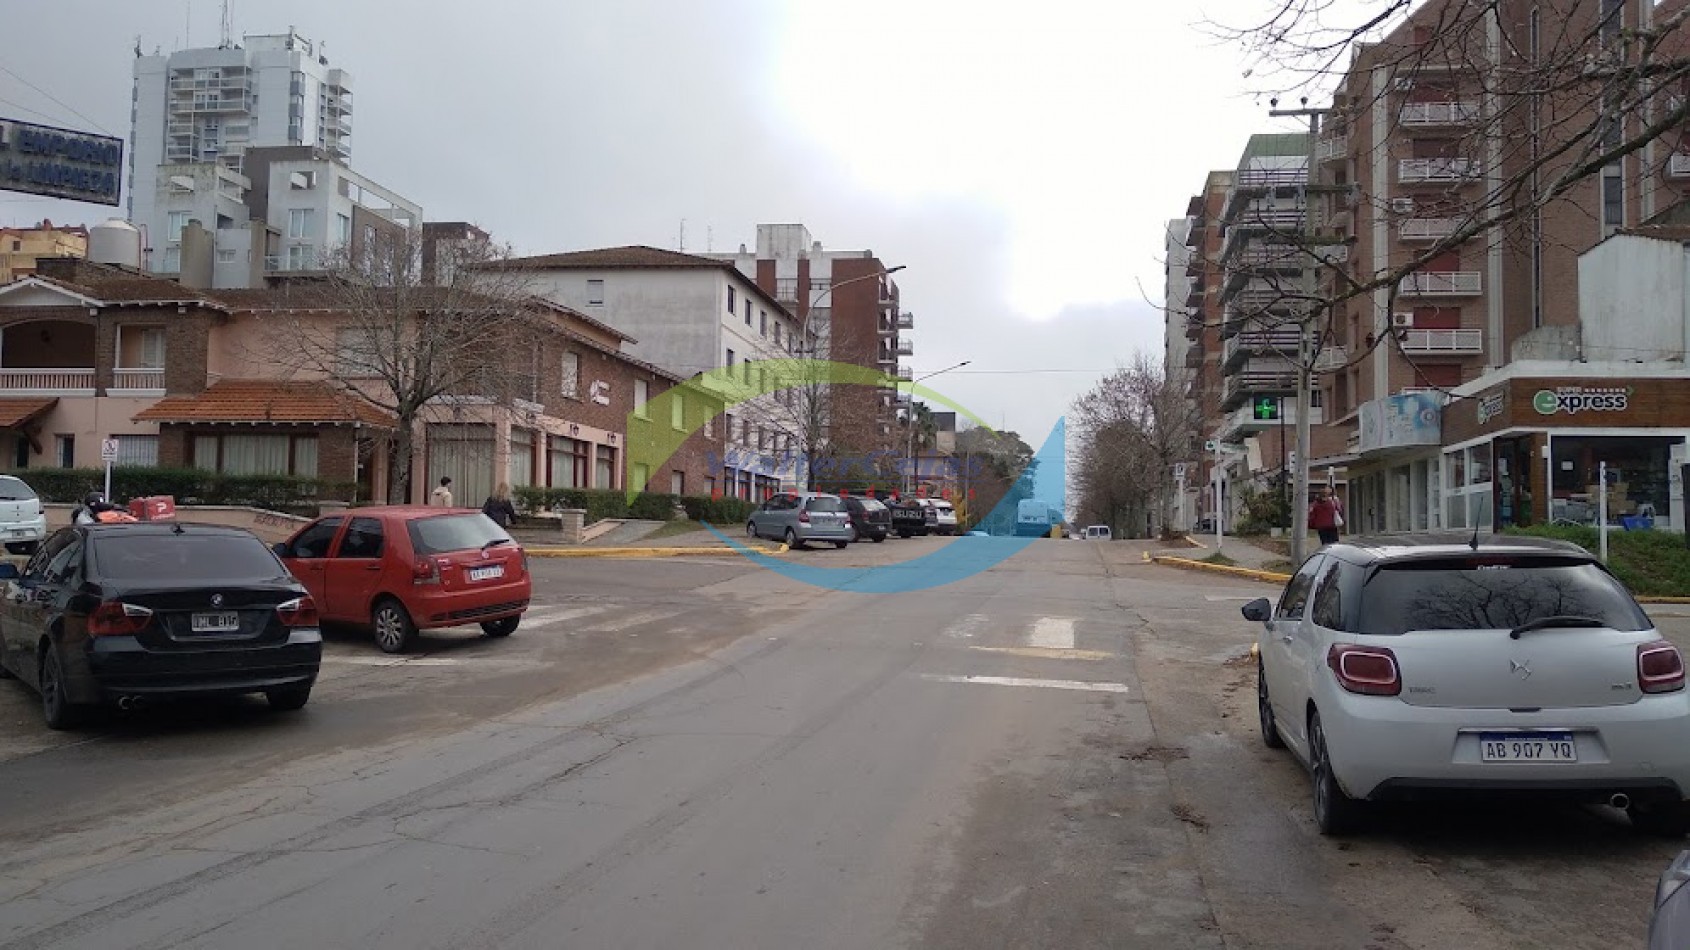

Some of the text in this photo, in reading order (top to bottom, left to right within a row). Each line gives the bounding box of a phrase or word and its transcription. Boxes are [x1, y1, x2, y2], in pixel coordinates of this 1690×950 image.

[19, 129, 118, 167] EMPORIO
[27, 160, 115, 195] LIMPIEZA
[1534, 390, 1628, 415] express
[1487, 743, 1572, 758] AB 907 YQ
